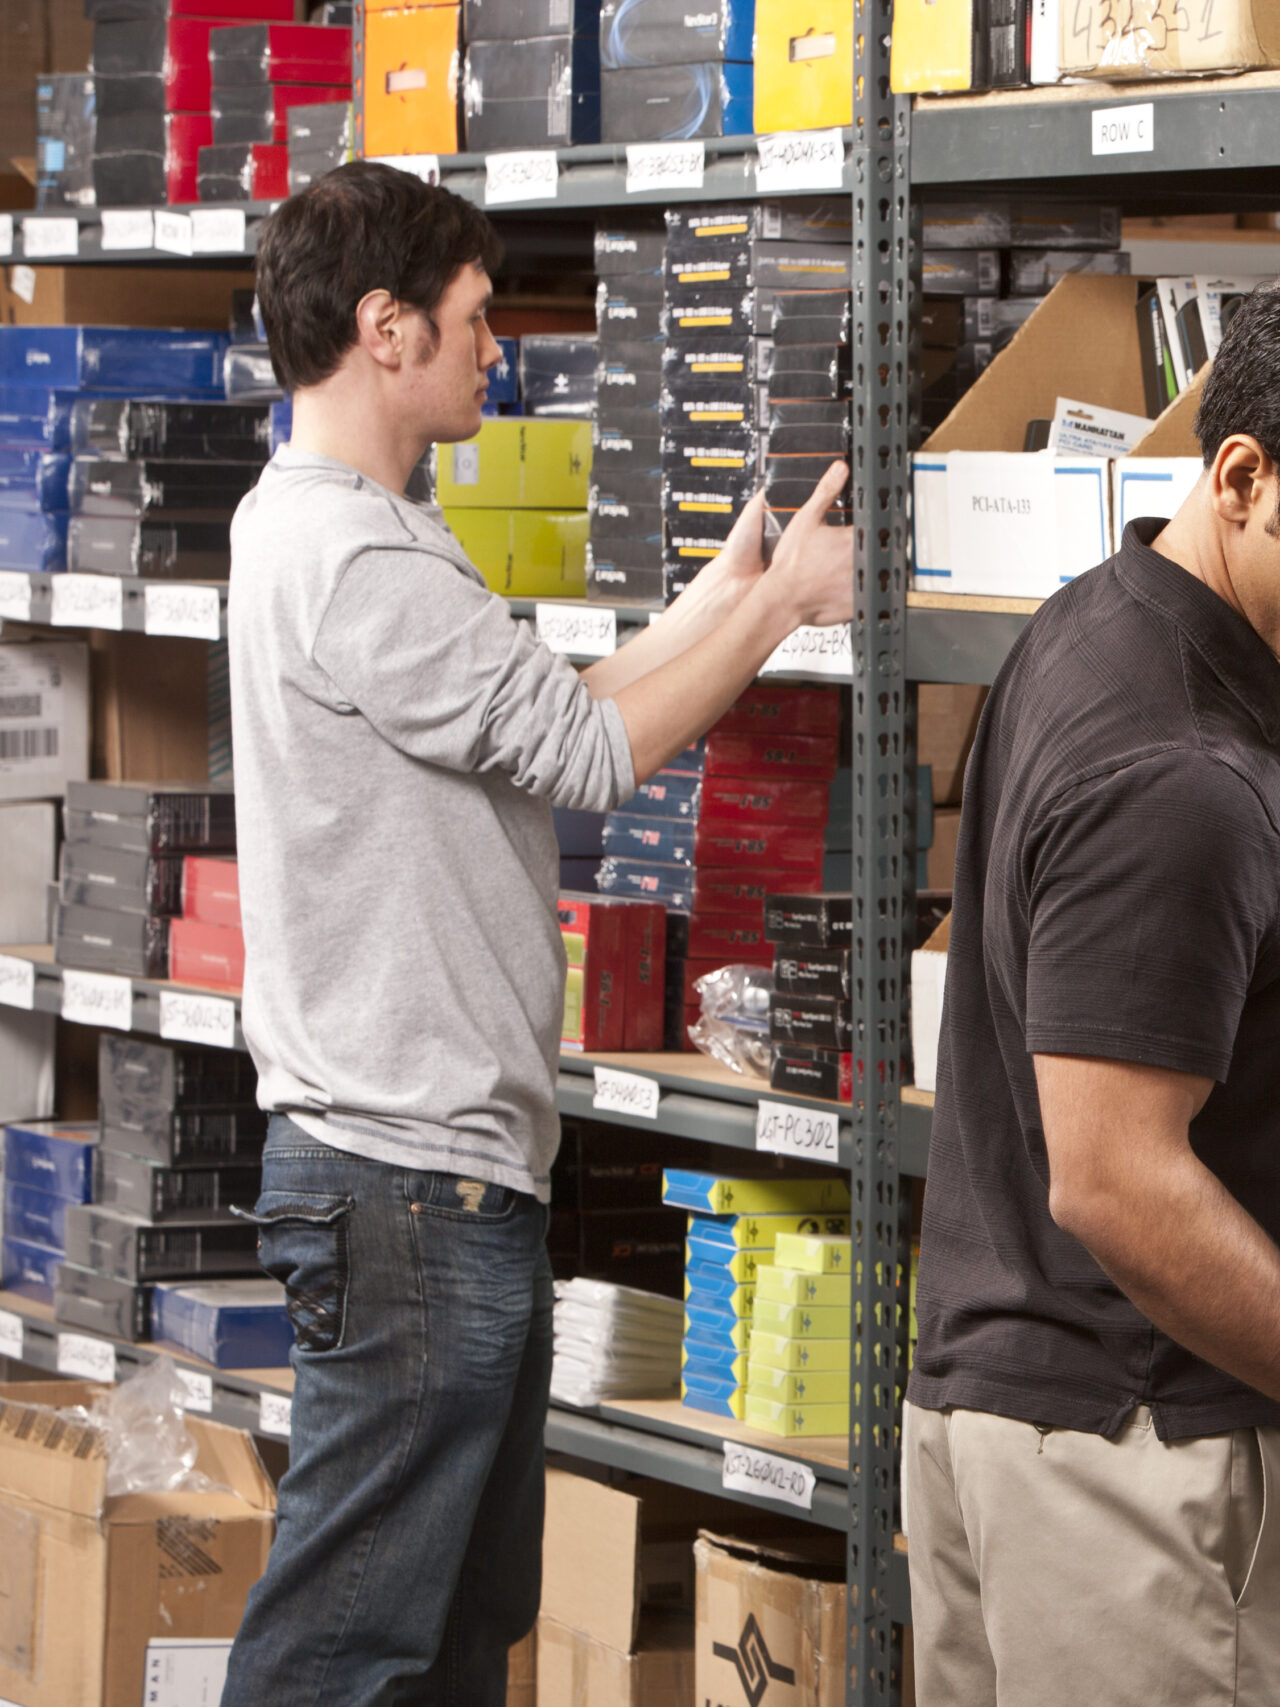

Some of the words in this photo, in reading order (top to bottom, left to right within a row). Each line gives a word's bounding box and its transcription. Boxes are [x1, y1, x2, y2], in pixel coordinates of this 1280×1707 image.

[1101, 122, 1130, 143] ROW
[1137, 120, 1144, 139] C
[1074, 421, 1125, 441] MANHATTAN
[972, 496, 1031, 514] PCI-ATA-133
